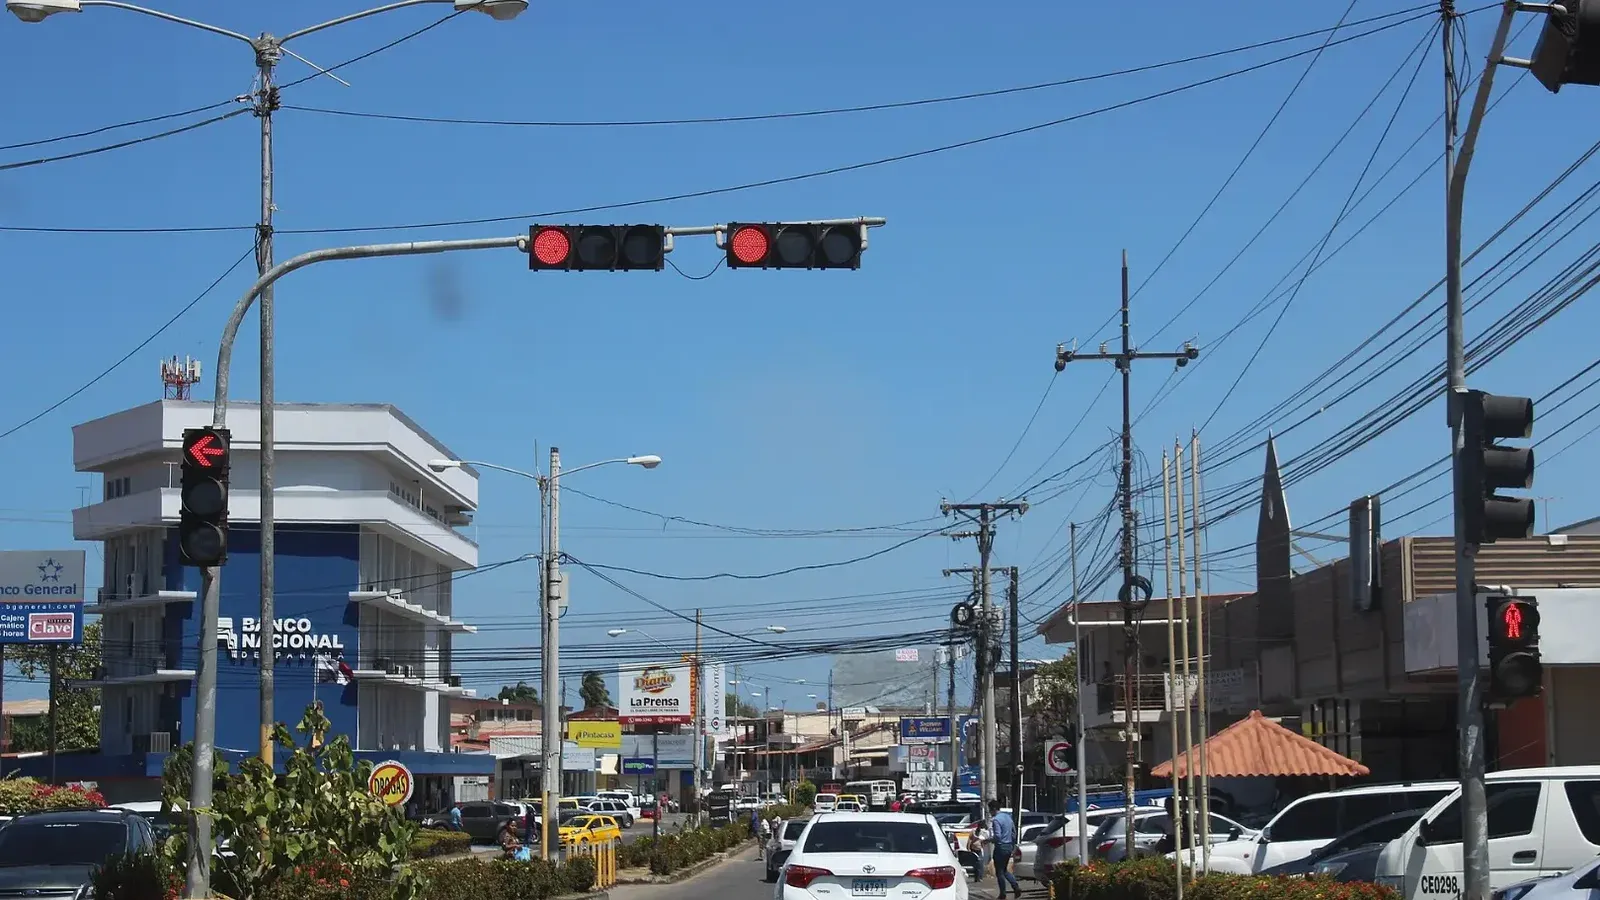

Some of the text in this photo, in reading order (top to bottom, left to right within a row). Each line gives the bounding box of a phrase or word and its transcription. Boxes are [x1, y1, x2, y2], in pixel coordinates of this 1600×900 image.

[0, 583, 77, 595] nco General
[1, 614, 25, 622] Cajero
[242, 617, 312, 632] BNCO
[31, 620, 71, 634] Clave
[242, 634, 344, 648] NCIONAL
[630, 697, 679, 706] La Prensa
[582, 730, 615, 739] Pintacasa
[374, 775, 406, 795] DROGAS
[1421, 876, 1458, 894] CE0298
